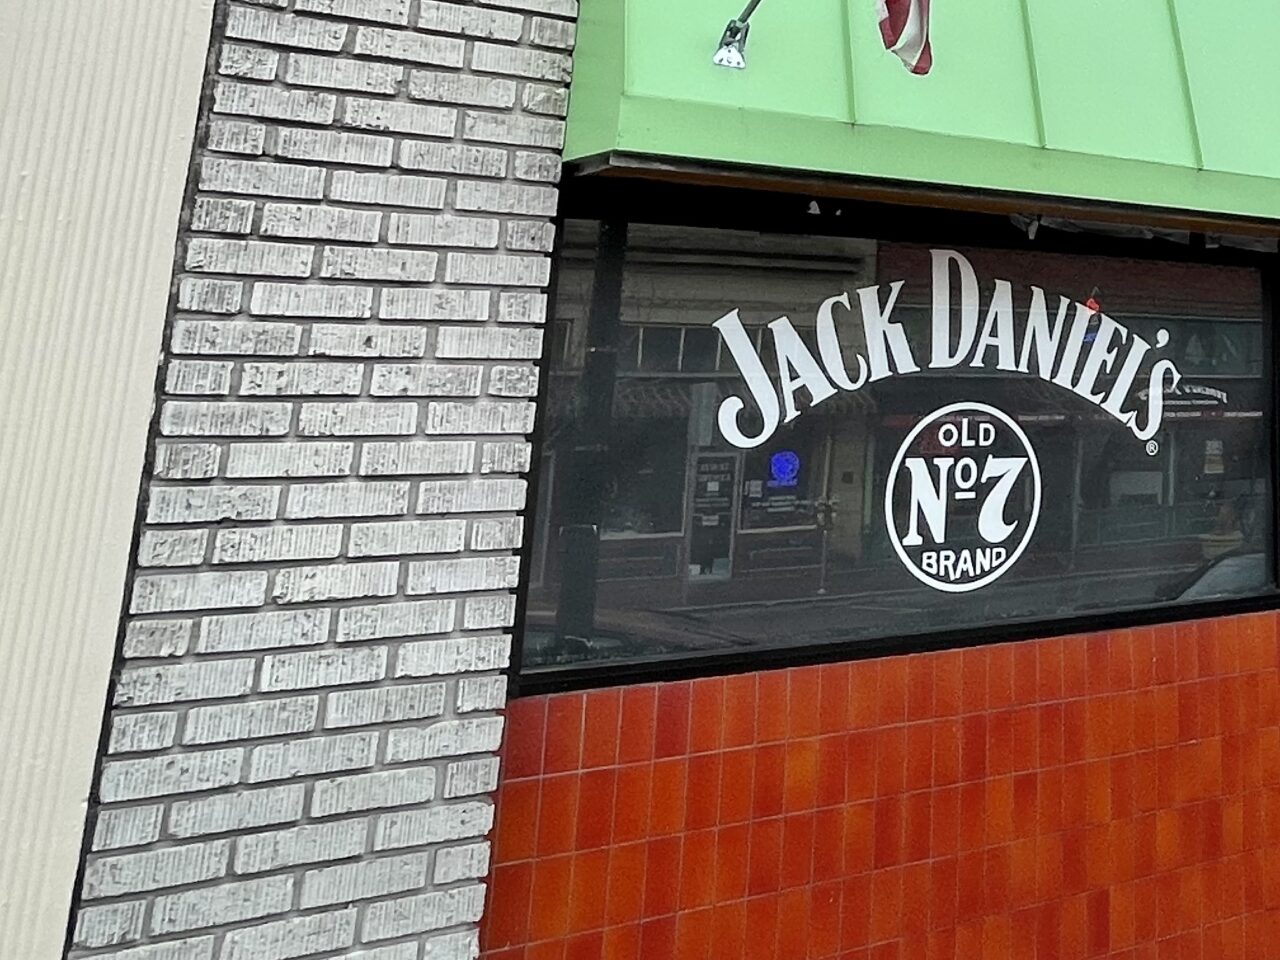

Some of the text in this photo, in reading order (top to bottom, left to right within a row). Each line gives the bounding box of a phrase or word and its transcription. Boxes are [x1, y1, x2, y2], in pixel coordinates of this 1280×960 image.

[712, 248, 1182, 448] JACK DANIEL'S
[938, 417, 995, 448] OLD
[920, 546, 1007, 581] BRAND
